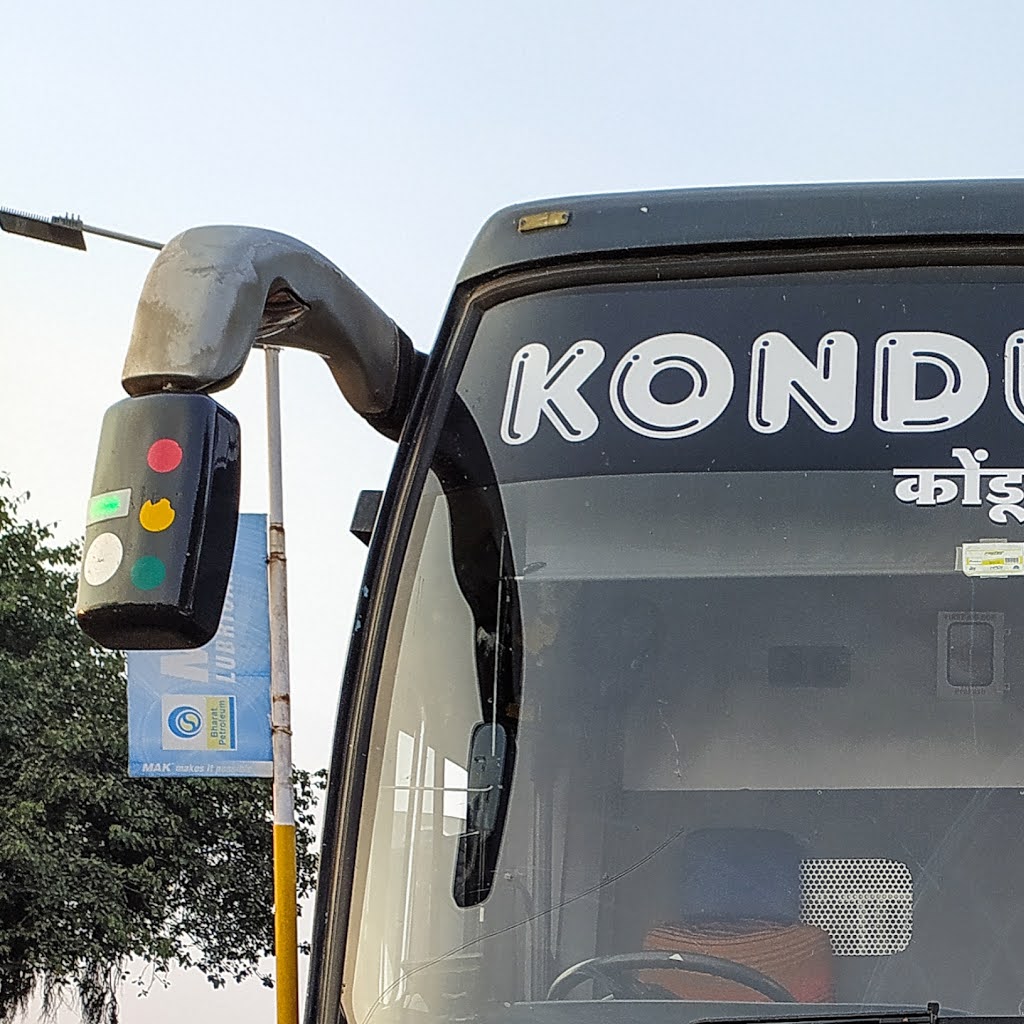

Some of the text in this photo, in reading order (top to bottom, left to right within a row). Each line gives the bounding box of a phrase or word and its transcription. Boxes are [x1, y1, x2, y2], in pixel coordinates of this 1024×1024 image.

[210, 708, 218, 738] Bharat
[218, 700, 226, 746] Petroleum
[142, 763, 171, 773] MAK
[175, 764, 204, 773] makes
[206, 764, 214, 772] it
